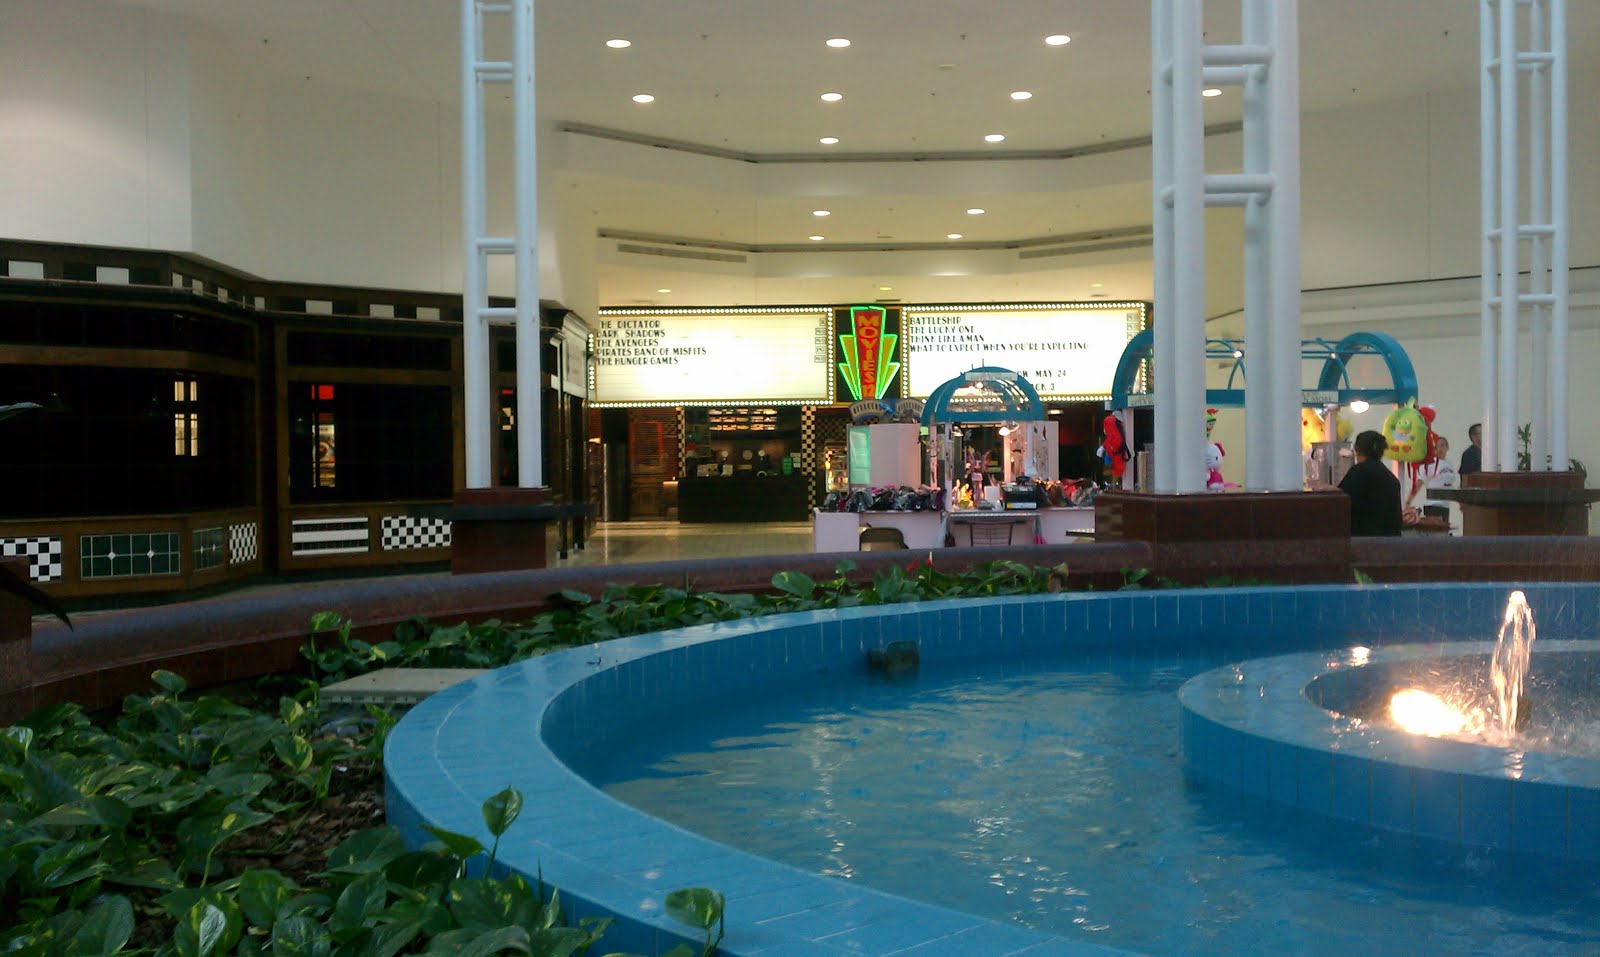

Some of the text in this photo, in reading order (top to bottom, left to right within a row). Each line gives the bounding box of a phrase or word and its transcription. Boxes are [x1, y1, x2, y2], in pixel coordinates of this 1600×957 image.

[601, 320, 661, 329] HE DICTATOR
[910, 316, 962, 325] BATTLESHIP
[625, 329, 666, 338] SHADOWS
[910, 325, 975, 334] THE LUCKY ONE
[596, 338, 659, 348] THE AVENGERS
[910, 334, 985, 343] THINK LIKE A MAN
[596, 346, 707, 357] PIRATES BAND OF MISFITS
[858, 315, 880, 383] MOVIES
[910, 344, 933, 352] WHAT
[936, 344, 946, 352] TO
[949, 343, 980, 352] EXPECT
[983, 343, 1006, 351] WHEN
[1041, 342, 1089, 351] EXPECTING
[597, 356, 679, 366] THE HUNGER GAMES
[1035, 370, 1052, 378] MAY
[1050, 383, 1055, 391] 3
